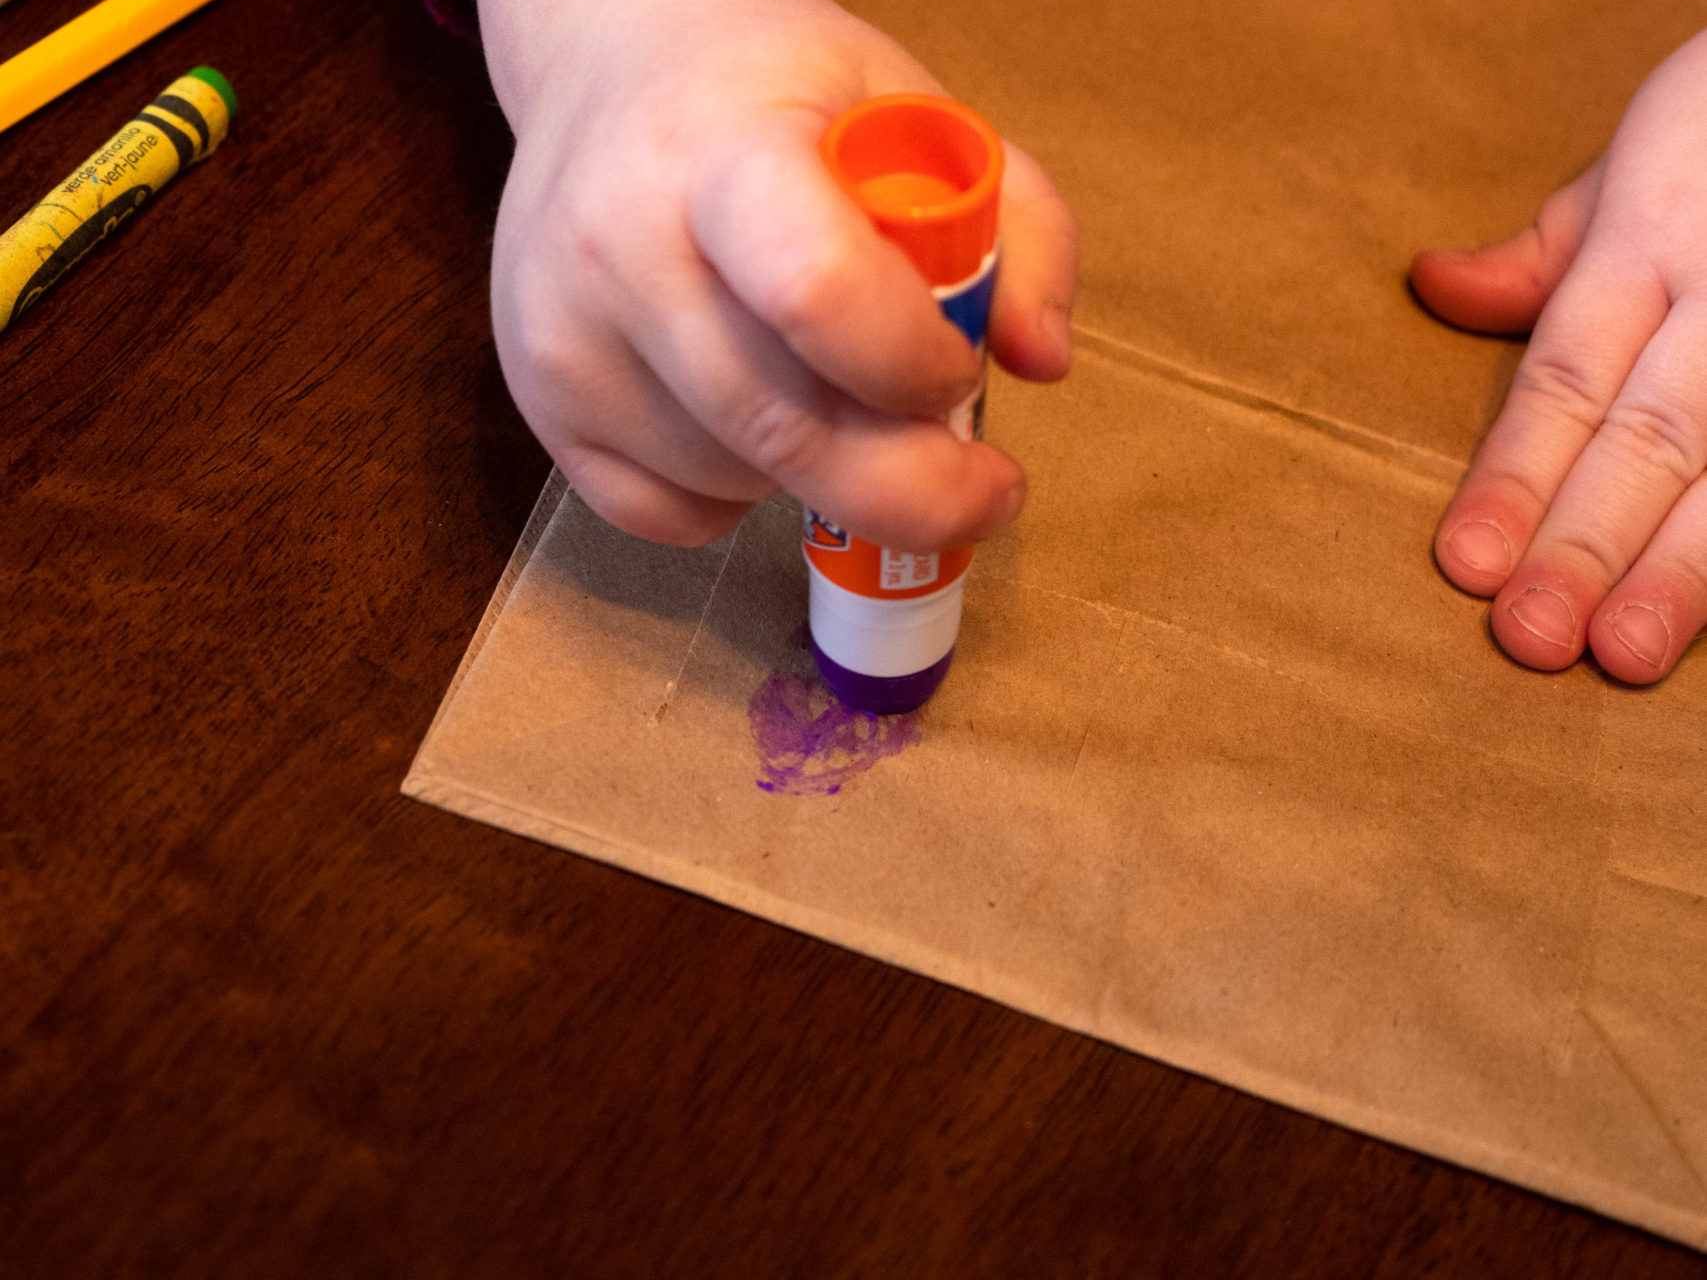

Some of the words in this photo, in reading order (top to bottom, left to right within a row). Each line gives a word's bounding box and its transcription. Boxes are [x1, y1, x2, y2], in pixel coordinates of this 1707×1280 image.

[62, 166, 98, 193] verde
[94, 127, 141, 166] amarillo
[100, 135, 158, 186] vert-jaune
